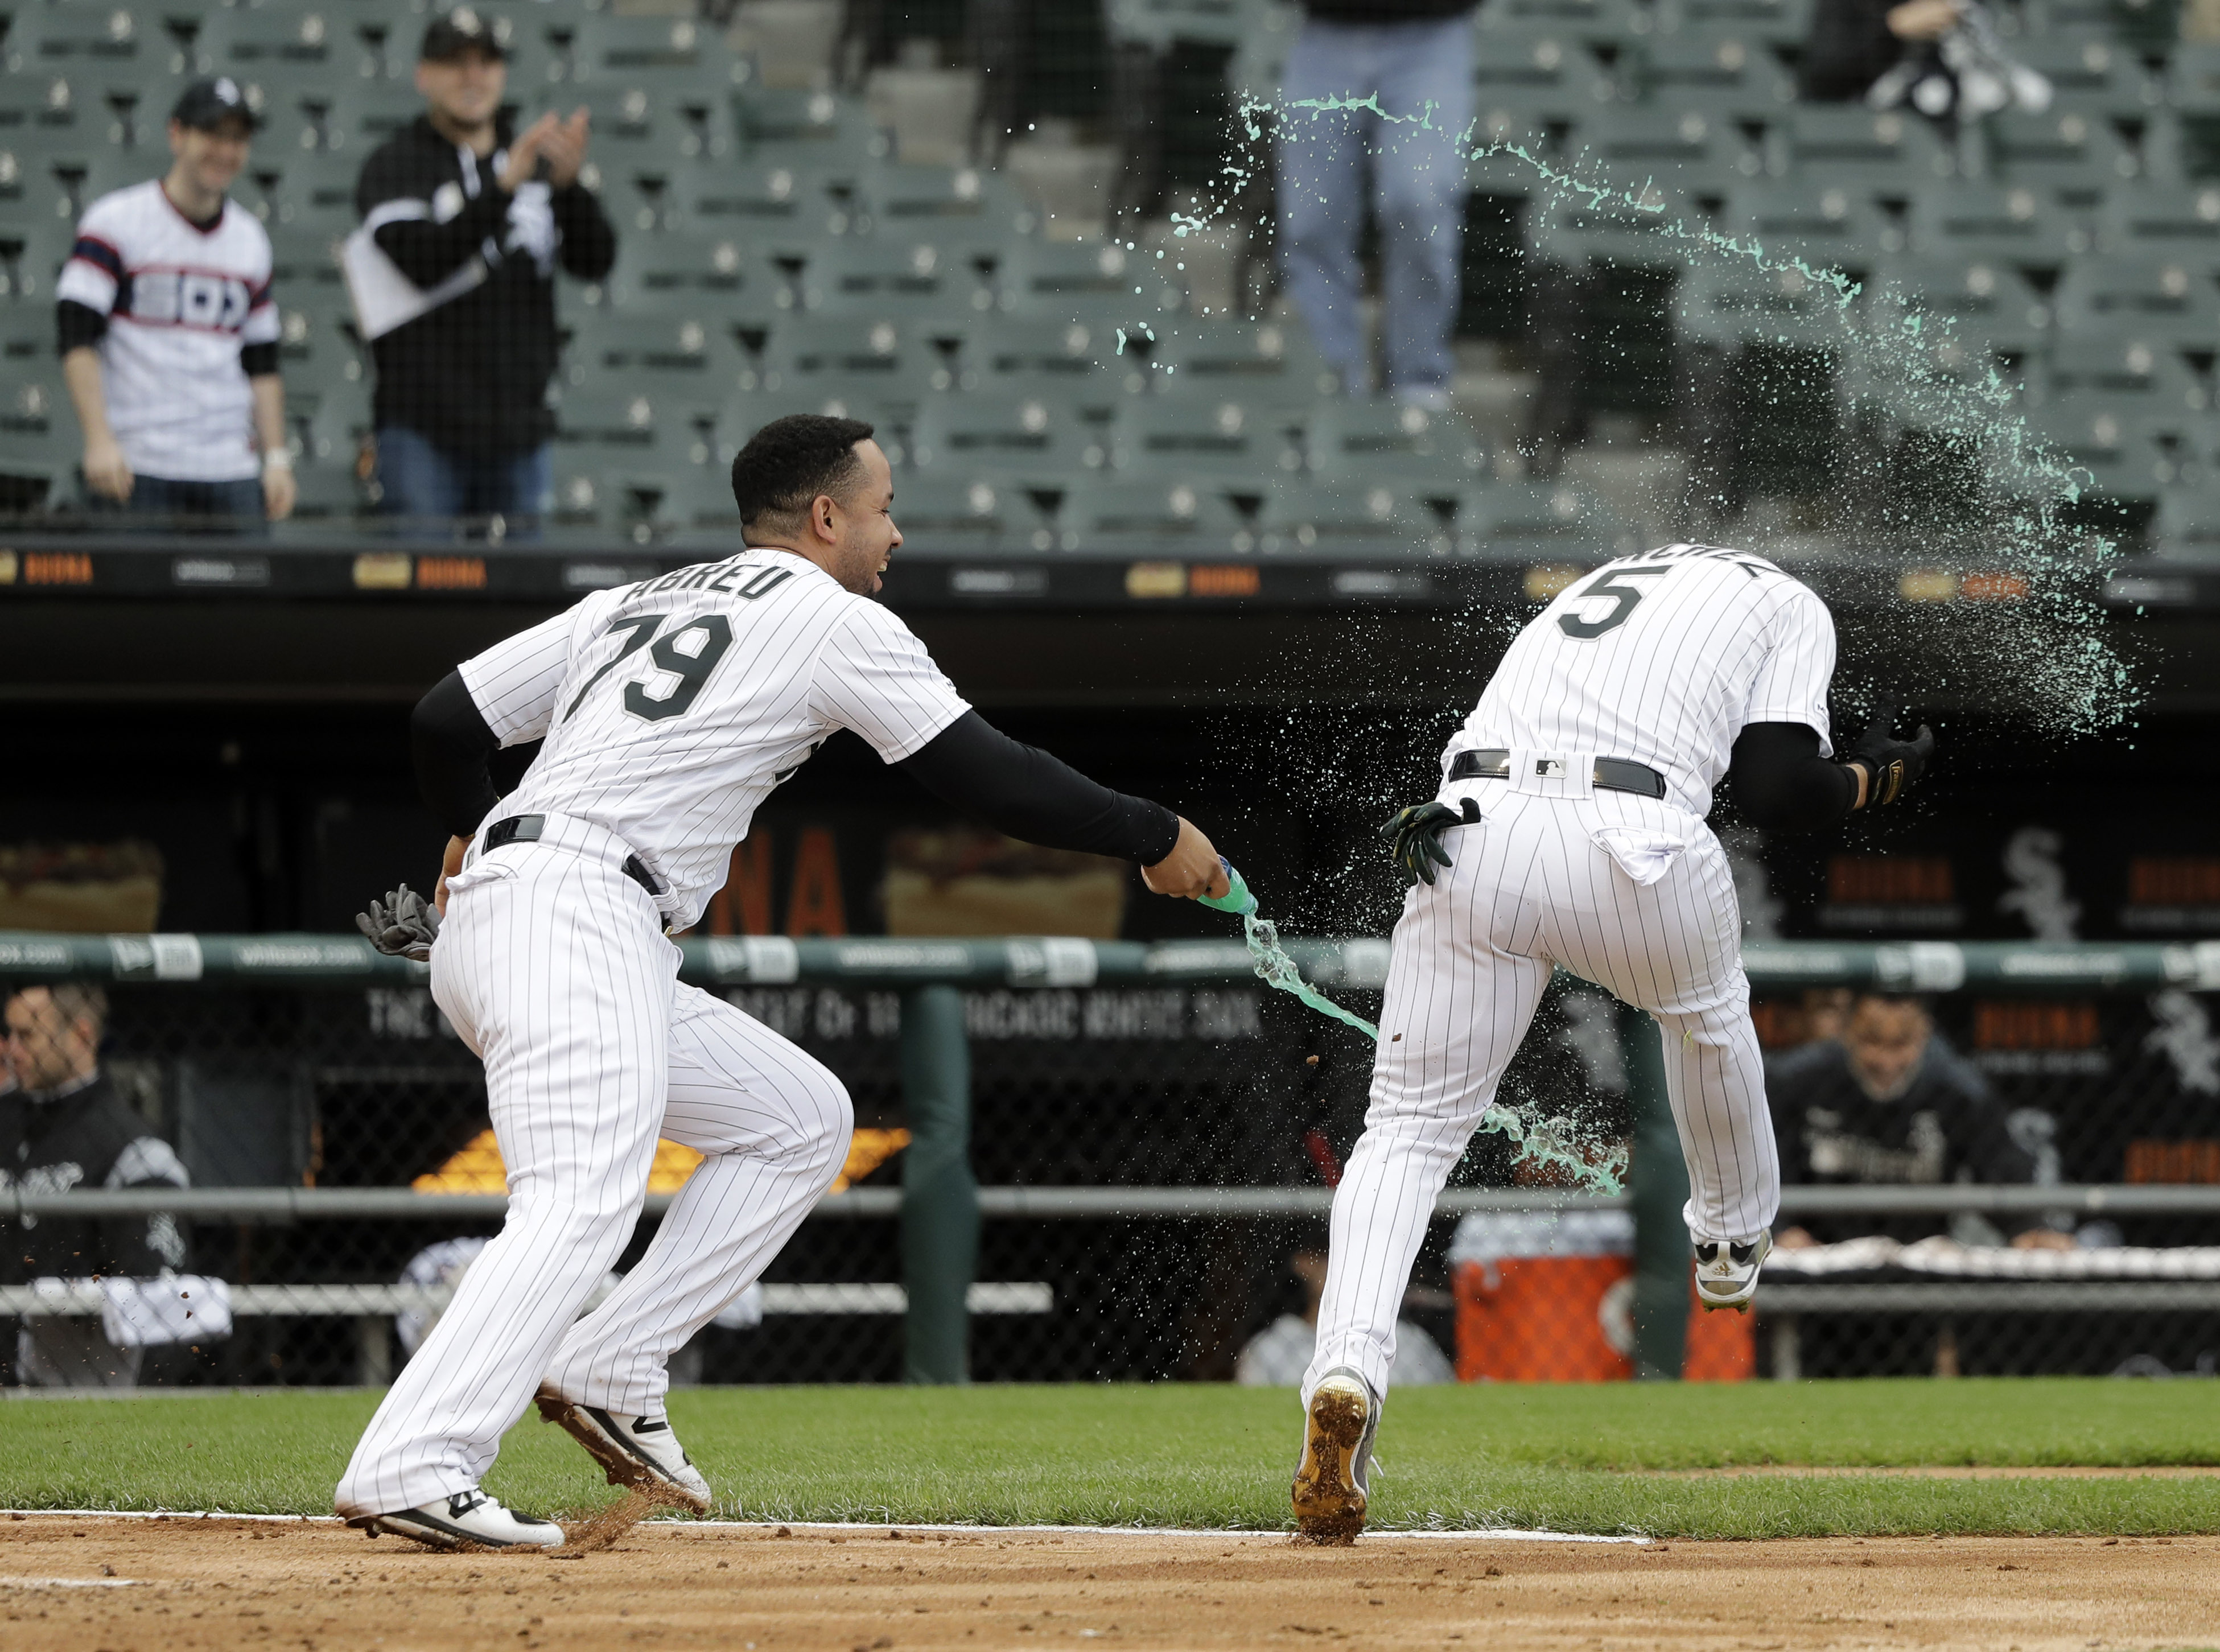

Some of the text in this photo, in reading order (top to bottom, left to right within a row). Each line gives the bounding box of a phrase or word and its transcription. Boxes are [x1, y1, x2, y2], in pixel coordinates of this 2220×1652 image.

[621, 563, 796, 604] ABREU
[1554, 564, 1678, 642] 5
[562, 612, 738, 726] 79
